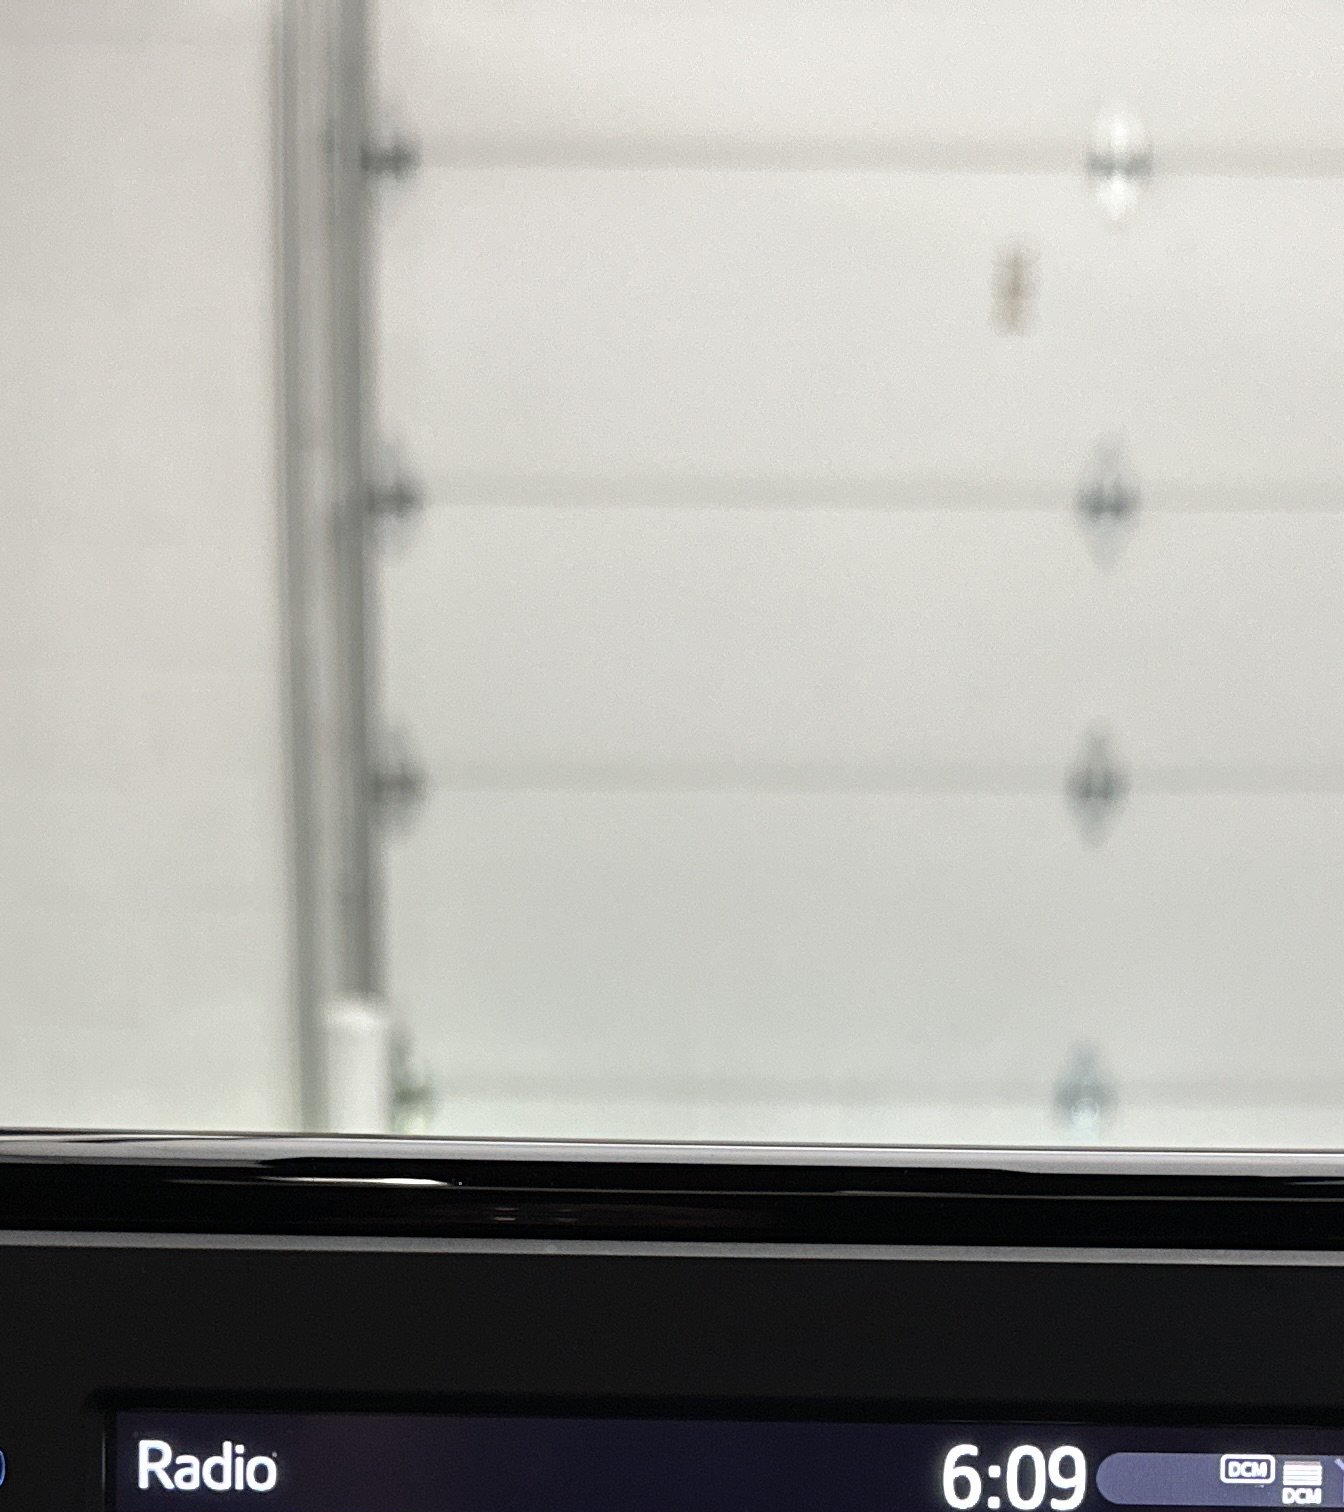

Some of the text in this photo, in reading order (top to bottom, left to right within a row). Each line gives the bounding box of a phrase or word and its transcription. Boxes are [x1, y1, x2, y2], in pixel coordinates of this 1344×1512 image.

[137, 1439, 277, 1492] Radio
[942, 1443, 1087, 1511] 6:09
[1227, 1461, 1268, 1478] DCM
[1282, 1487, 1322, 1504] DCM
